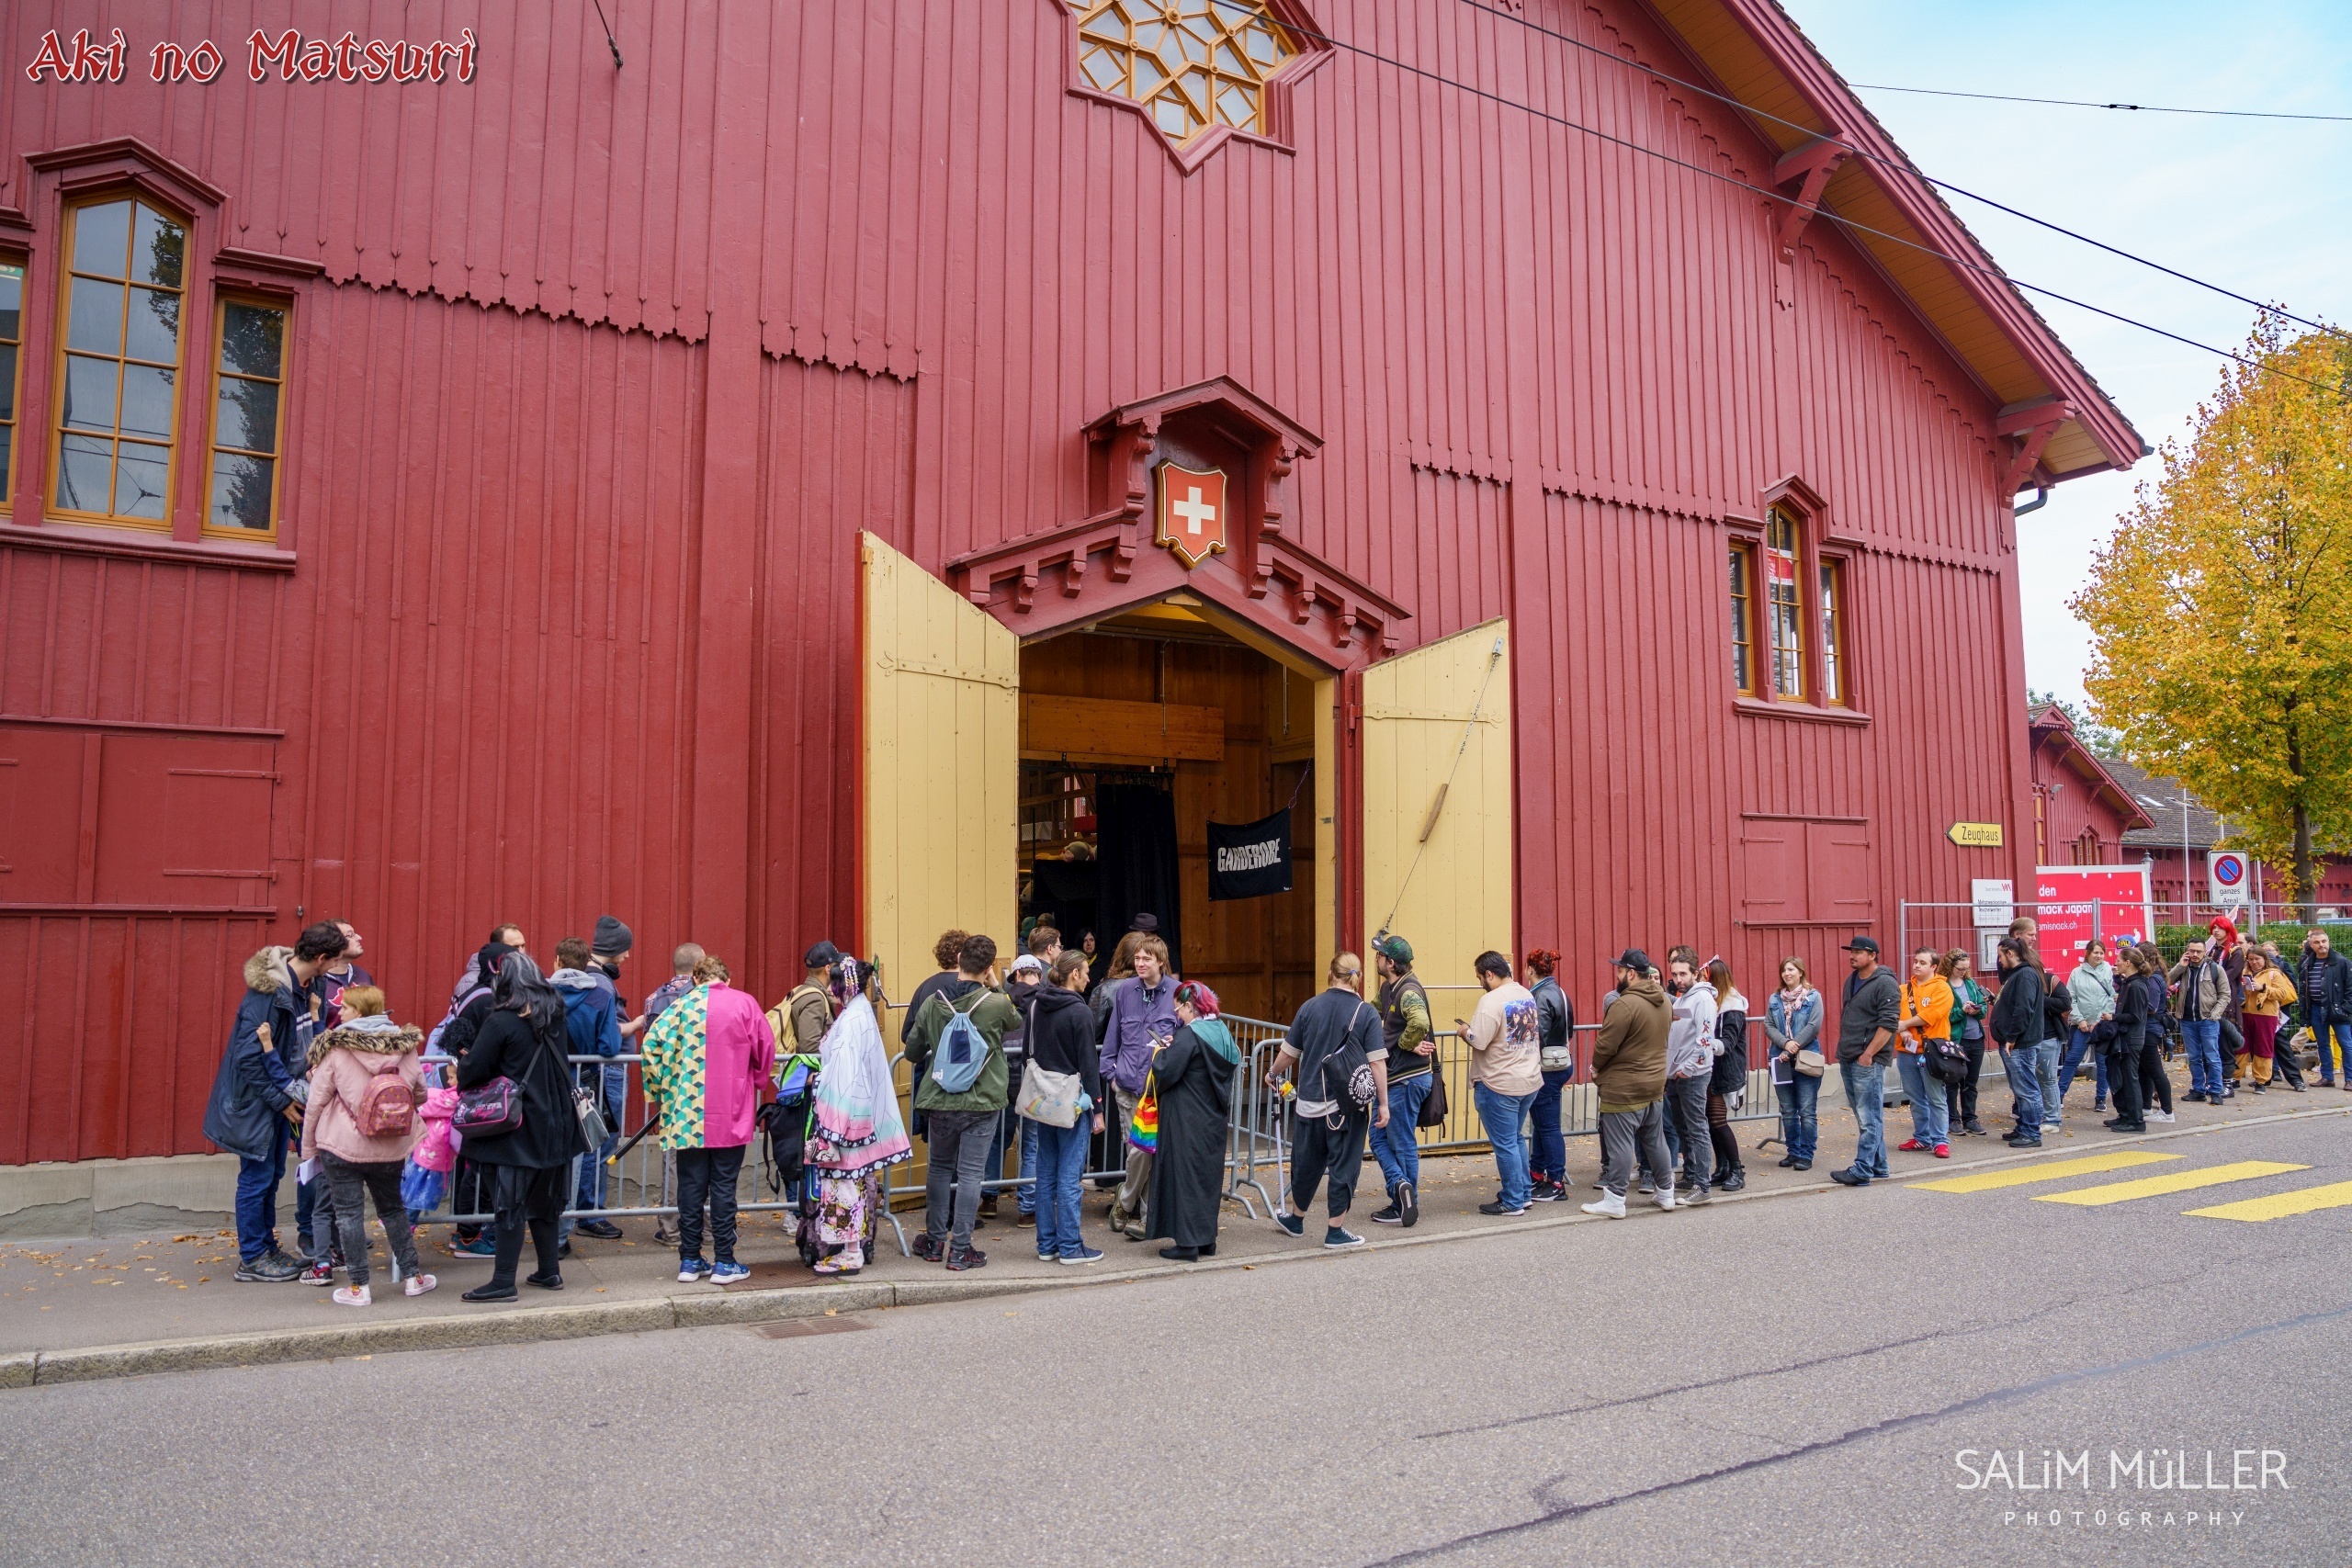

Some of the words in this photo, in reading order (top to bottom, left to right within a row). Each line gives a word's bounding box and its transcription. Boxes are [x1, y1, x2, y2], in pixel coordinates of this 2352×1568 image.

[1962, 826, 1998, 844] Zeughaus
[1217, 837, 1281, 872] GARDEROBE
[2039, 885, 2056, 897] den
